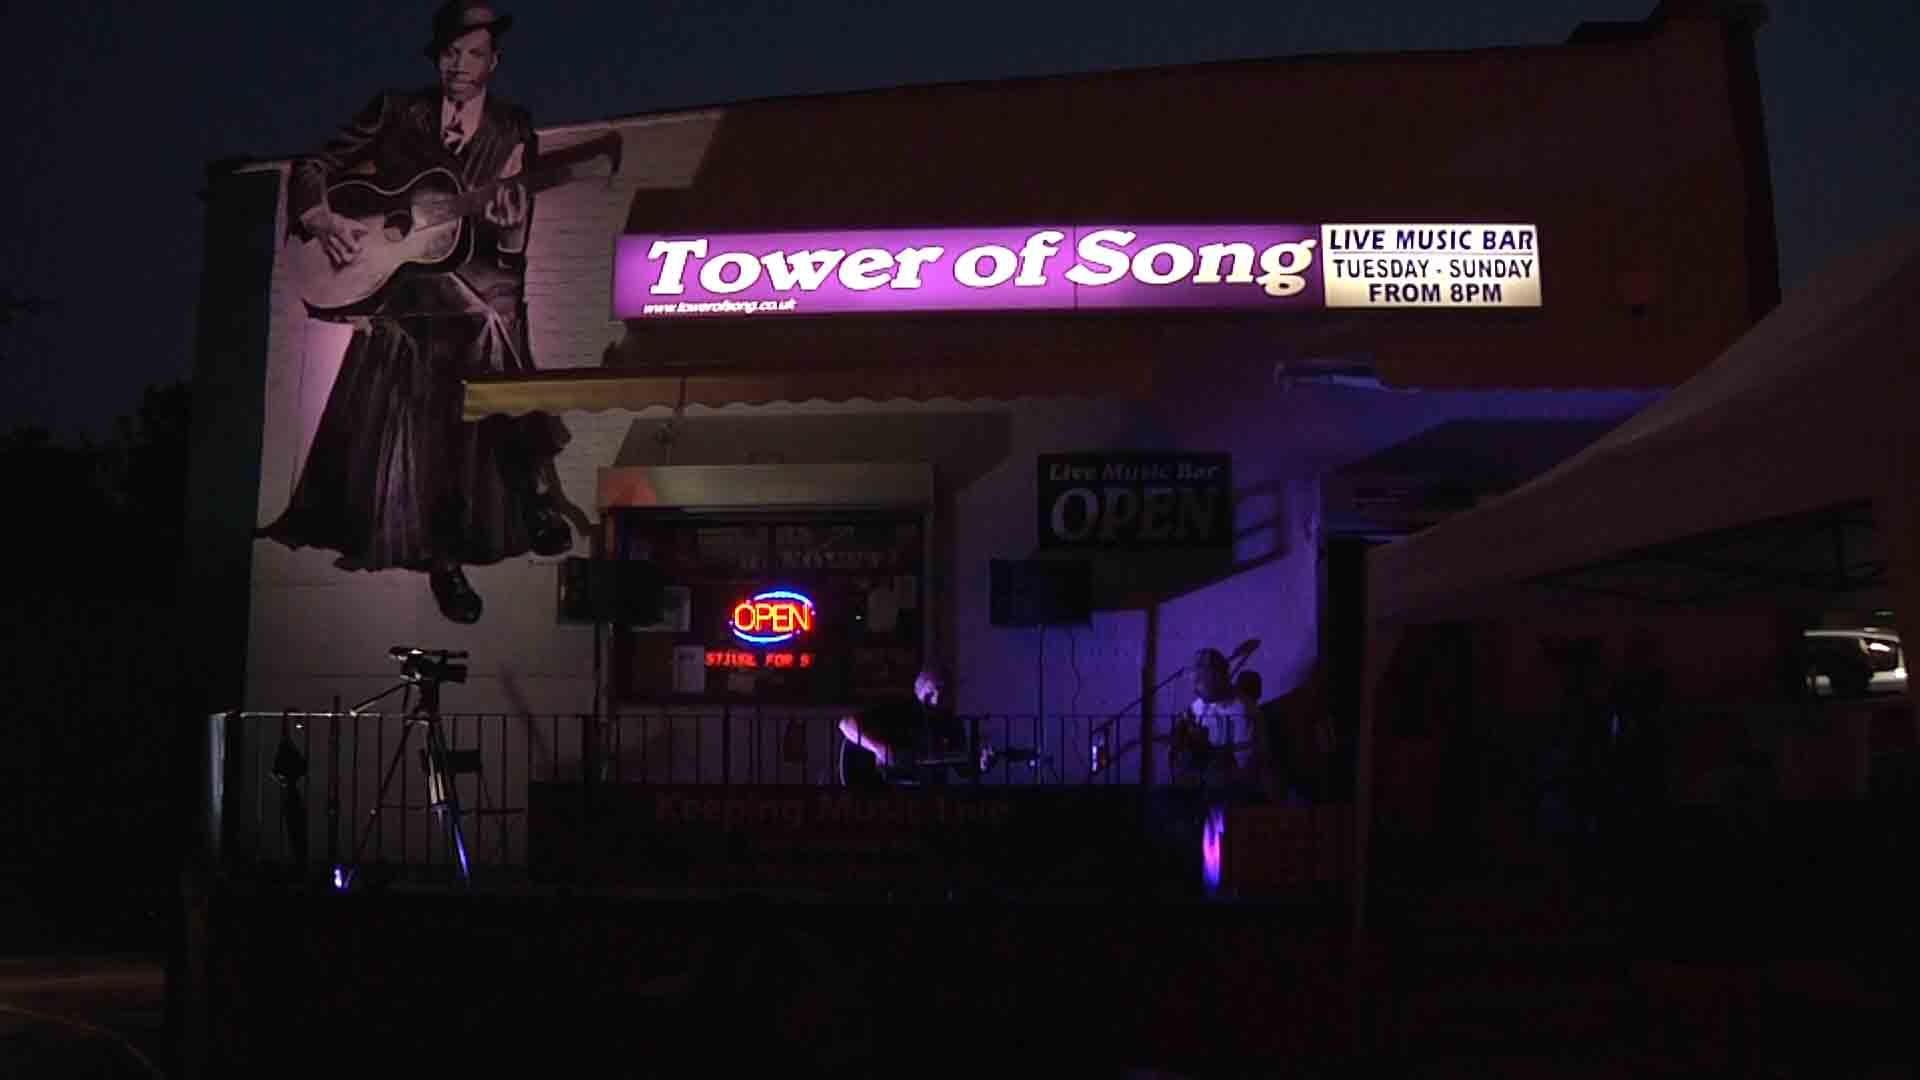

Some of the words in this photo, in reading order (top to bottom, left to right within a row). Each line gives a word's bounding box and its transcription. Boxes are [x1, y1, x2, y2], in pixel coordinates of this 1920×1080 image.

[1330, 229, 1386, 250] LIVE
[1396, 229, 1472, 250] MUSIC
[1483, 230, 1534, 250] BAR
[647, 239, 944, 295] Tower
[952, 230, 1065, 288] of
[1064, 229, 1318, 297] Song
[1333, 259, 1429, 278] TUESDAY
[1450, 259, 1533, 278] SUNDAY
[1369, 283, 1441, 303] FROM
[1450, 283, 1502, 303] 8PM
[1176, 461, 1219, 480] Bar
[1051, 487, 1219, 543] OPEN
[734, 603, 809, 632] OPEN
